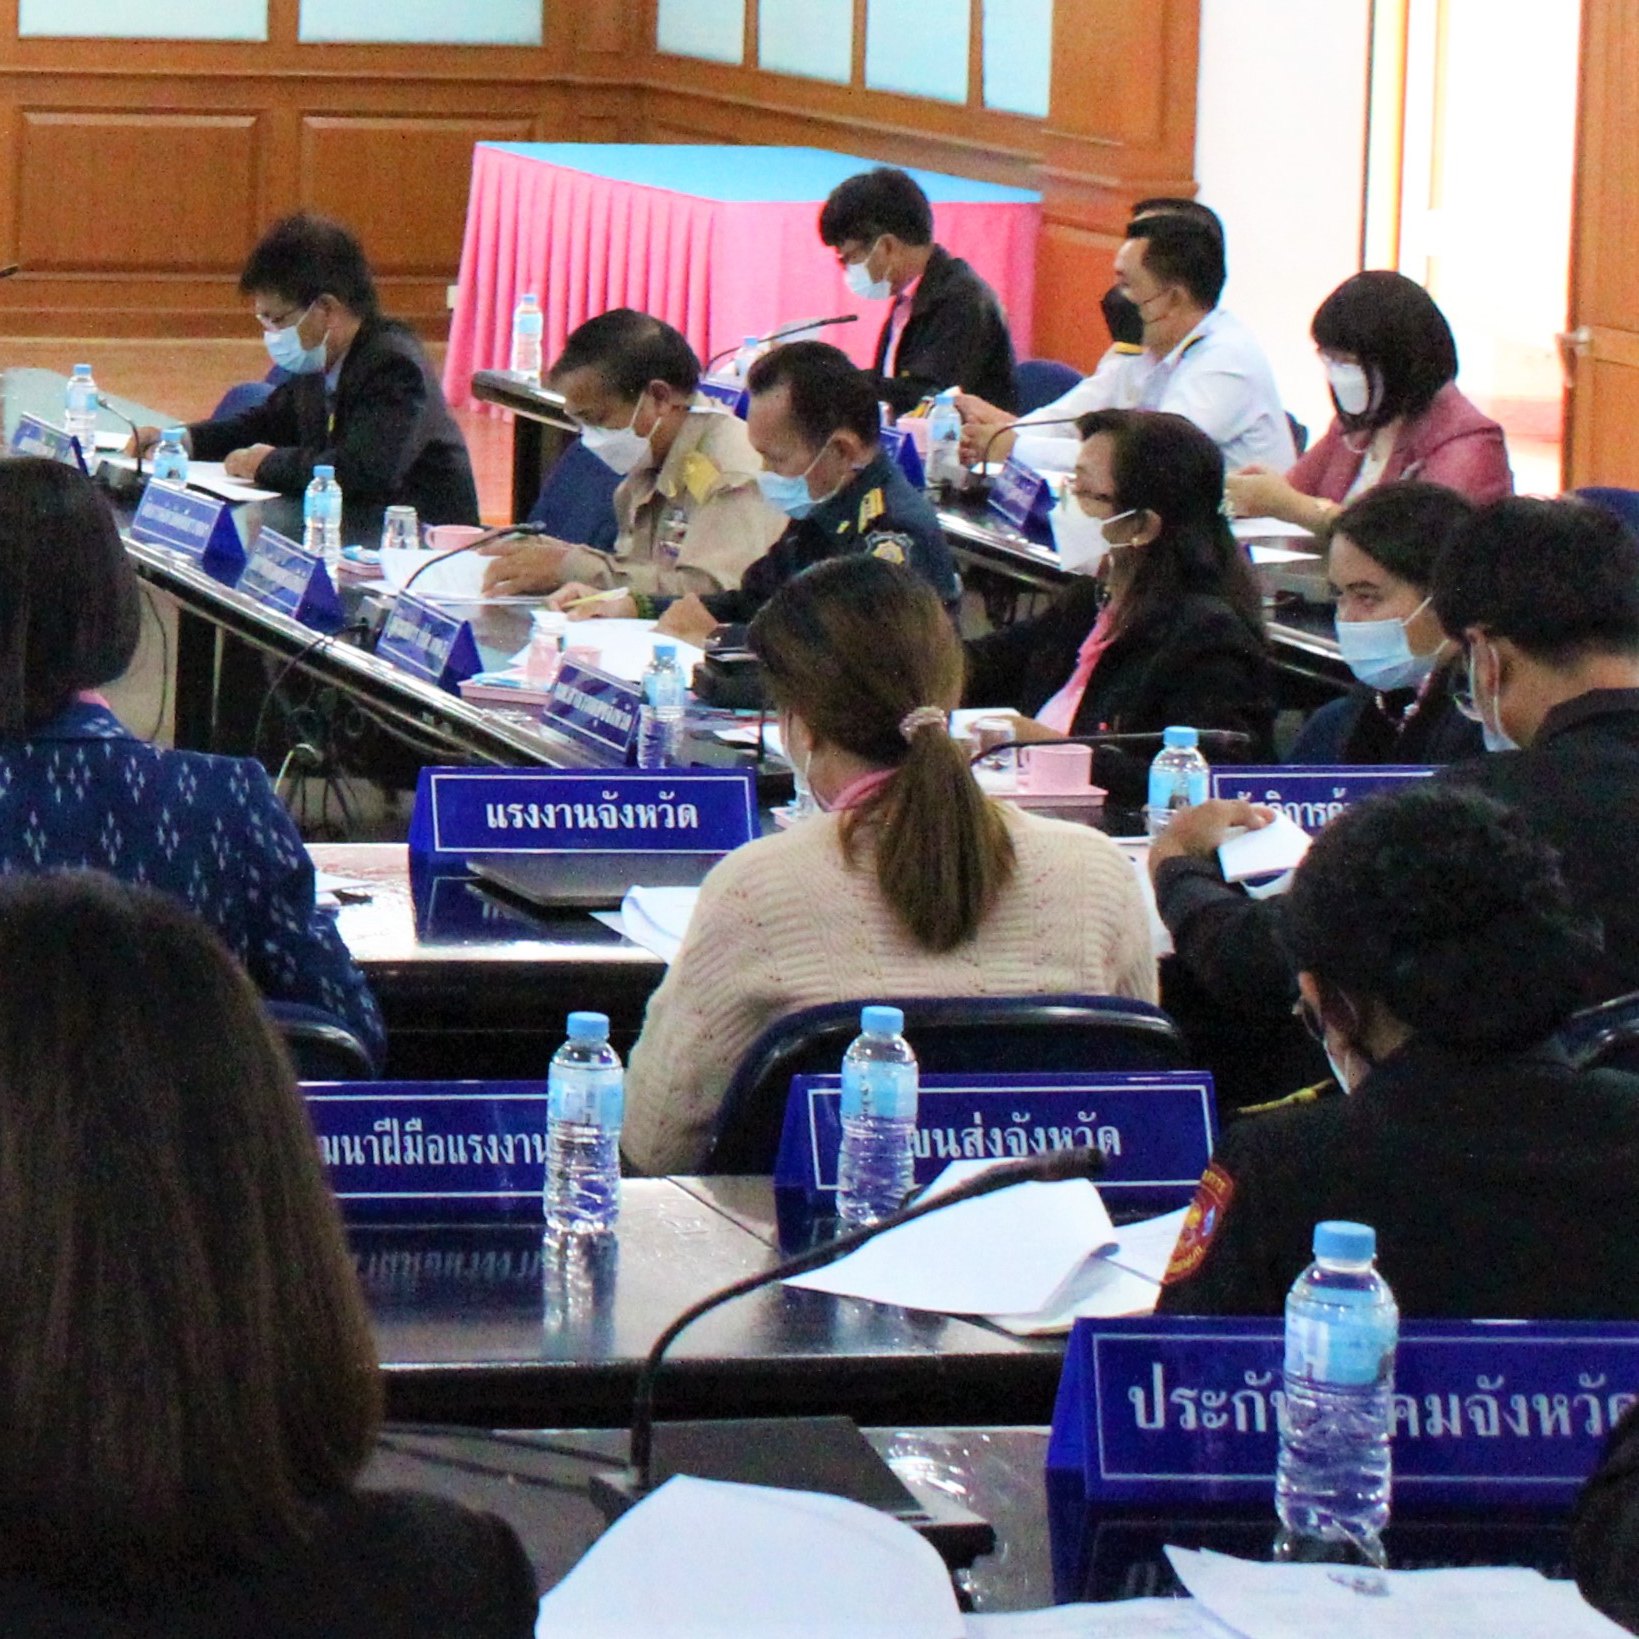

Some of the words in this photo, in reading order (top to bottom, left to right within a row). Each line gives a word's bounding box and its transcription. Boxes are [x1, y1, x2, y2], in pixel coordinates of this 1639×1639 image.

[486, 791, 699, 829] แรงงานจังหวัด
